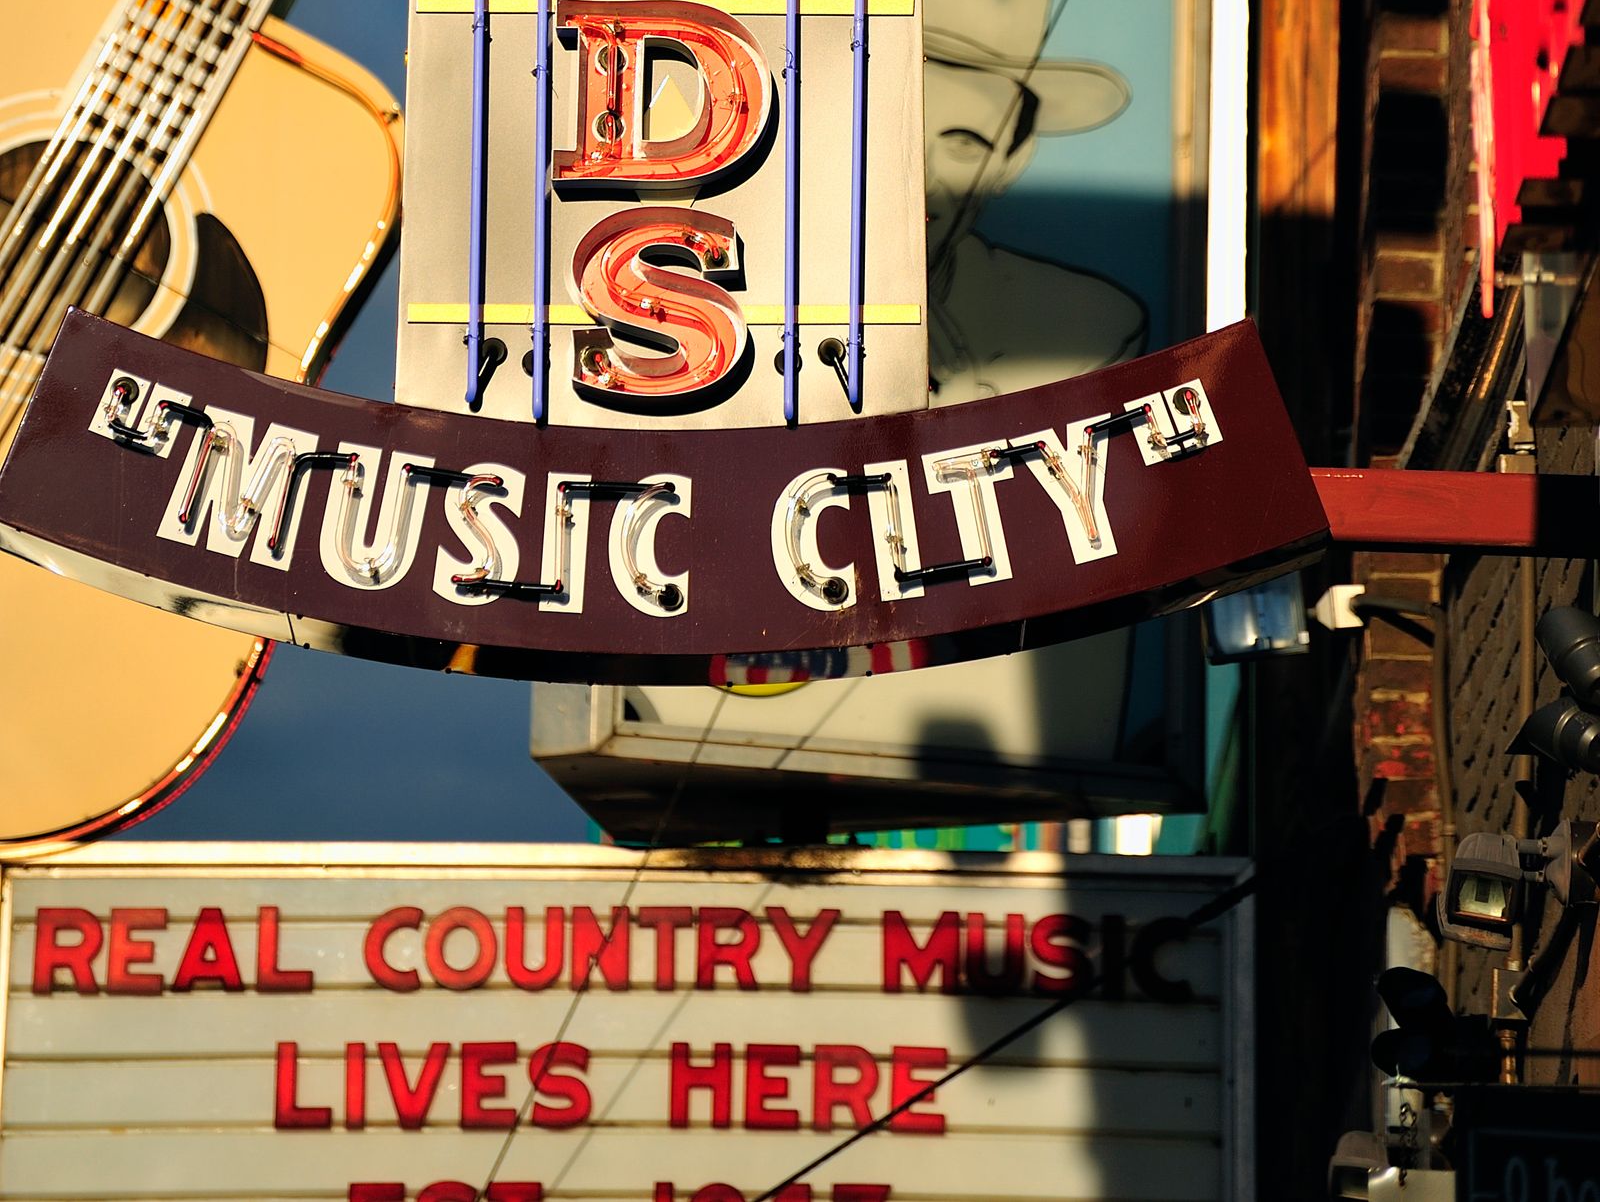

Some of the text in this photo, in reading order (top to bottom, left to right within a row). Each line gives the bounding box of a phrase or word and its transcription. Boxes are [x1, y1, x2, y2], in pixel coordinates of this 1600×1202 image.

[32, 905, 1198, 1001] REAL COUNTRY MUSIC
[273, 1041, 949, 1136] LIVES HERE
